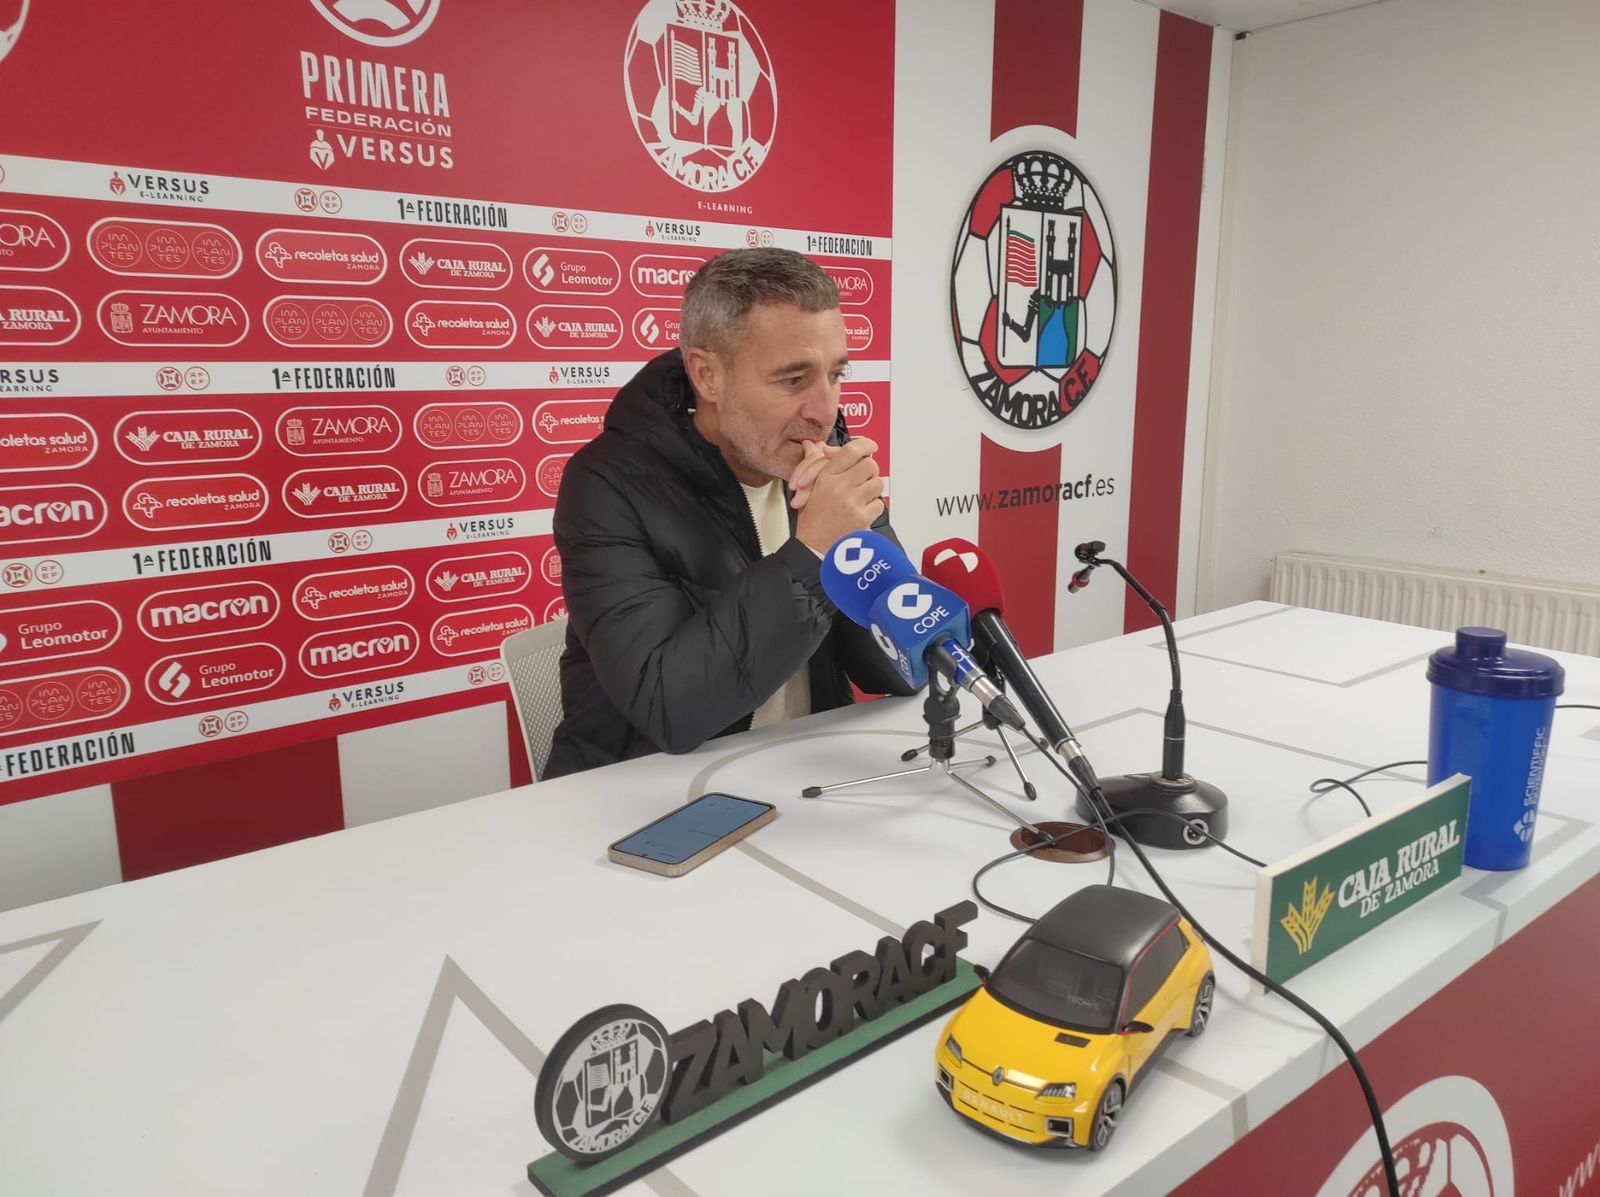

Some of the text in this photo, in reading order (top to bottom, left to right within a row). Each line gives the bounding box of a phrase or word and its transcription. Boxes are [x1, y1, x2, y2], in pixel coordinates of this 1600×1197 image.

[300, 51, 450, 117] PRIMERA
[306, 106, 451, 137] FEDERACIÓN
[336, 134, 453, 169] VERSUS
[128, 173, 209, 194] VERSUS
[140, 191, 204, 202] E-LEARNING
[418, 200, 508, 228] FEDERACIÓN
[697, 201, 753, 214] E-LEARNING
[656, 223, 701, 236] VERSUS
[819, 236, 872, 256] FEDERACIÓN
[295, 250, 378, 263] recoletas salud
[437, 259, 506, 272] CAJA RURAL
[561, 262, 586, 272] Grupo
[561, 273, 613, 285] Leomotor
[9, 309, 70, 322] RURAL
[140, 304, 237, 326] ZAMORA
[2, 322, 53, 330] ZAMORA
[438, 319, 509, 328] recoletas salud
[558, 322, 617, 332] CAJA RURAL
[482, 329, 511, 337] ZAMORA
[294, 365, 395, 389] FEDERACIÓN
[560, 367, 610, 377] VERSUS
[969, 364, 1062, 428] ZAMORA
[312, 417, 392, 436] ZAMORA
[560, 414, 599, 425] recoletas
[50, 433, 87, 445] salud
[163, 429, 253, 442] CAJA RURAL
[44, 446, 88, 454] ZAMORA
[199, 440, 239, 448] ZAMORA
[449, 469, 517, 487] ZAMORA
[323, 483, 399, 497] CAJA RURAL
[936, 474, 1115, 516] www.zamoracf.es
[166, 490, 259, 507] recoletas salud
[339, 493, 388, 503] DE ZAMORA
[224, 502, 261, 511] ZAMORA
[459, 518, 514, 532] VERSUS
[467, 530, 510, 539] E-LEARNING
[158, 538, 272, 573] FEDERACIÓN
[461, 567, 525, 583] CAJA RURAL
[486, 577, 515, 586] ZAMORA
[857, 559, 891, 590] COPE
[329, 580, 408, 599] recoletas salud
[377, 591, 408, 599] ZAMORA
[150, 595, 269, 627] macron
[461, 617, 528, 636] recoletas salud
[913, 605, 950, 634] COPE
[18, 622, 62, 635] Grupo
[21, 630, 108, 650] Leomotor
[310, 635, 409, 666] macron
[200, 662, 236, 675] Grupo
[202, 668, 274, 688] Leomotor
[343, 682, 404, 702] VERSUS
[351, 695, 399, 709] E-LEARNING
[6, 732, 135, 776] FEDERACIÓN
[1338, 819, 1460, 908] CAJA RURAL
[1360, 859, 1439, 918] DE ZAMORA
